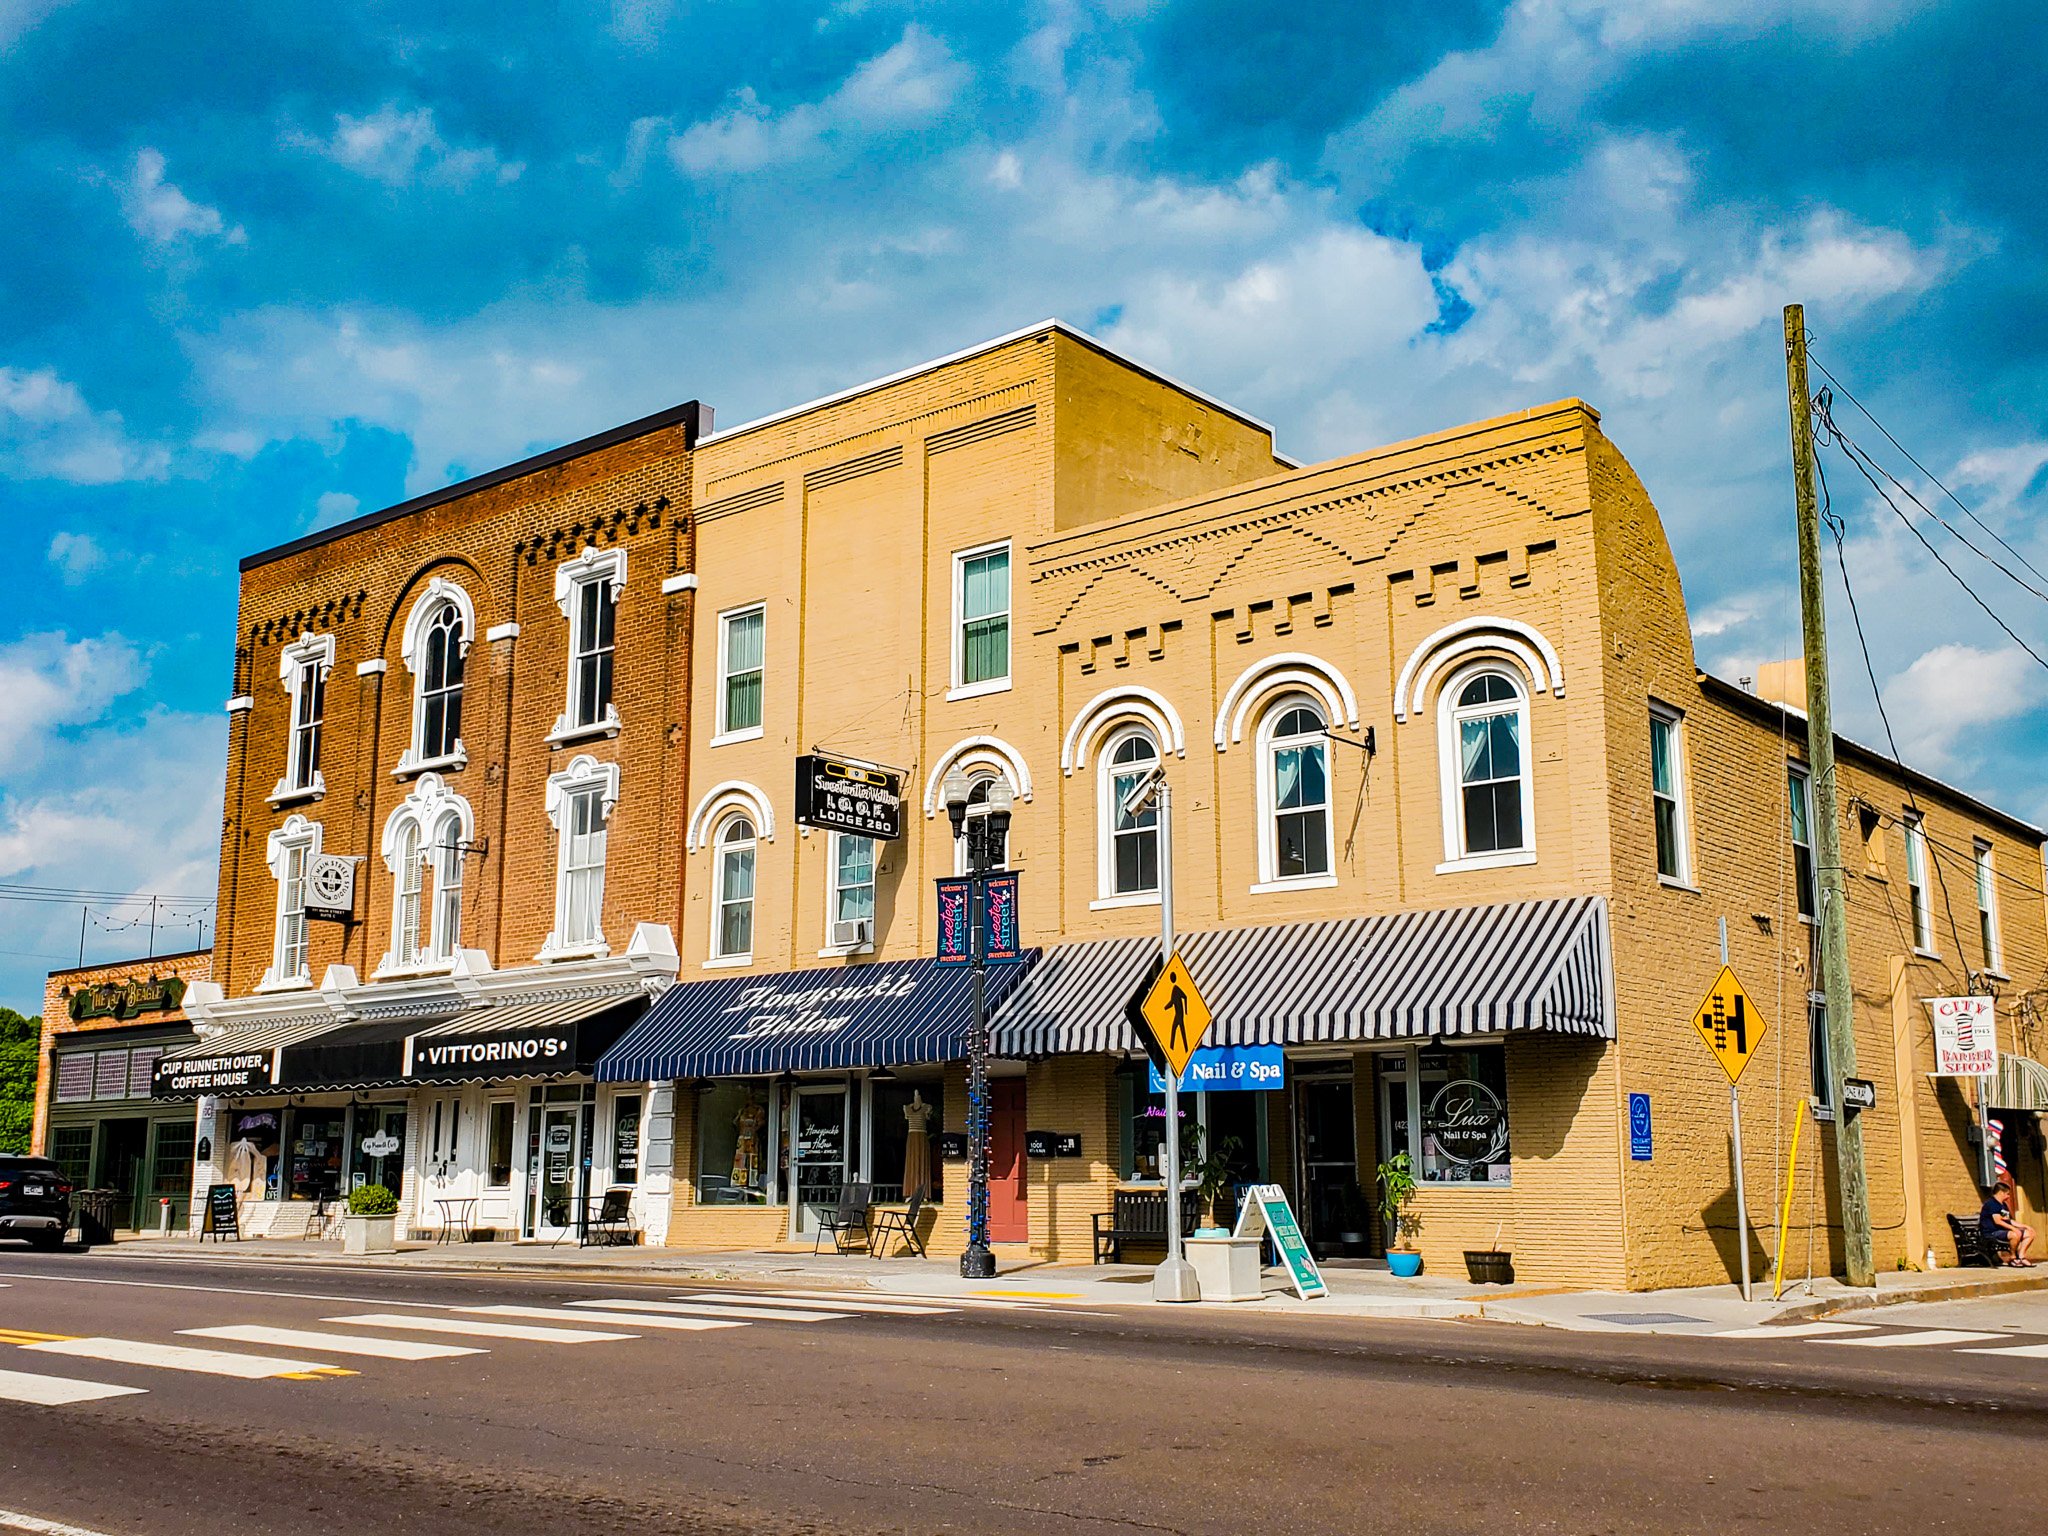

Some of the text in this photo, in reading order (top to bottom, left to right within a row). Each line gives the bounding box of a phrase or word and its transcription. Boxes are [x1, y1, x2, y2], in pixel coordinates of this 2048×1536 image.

[819, 808, 892, 832] LODGE 280
[315, 861, 329, 874] MAIN
[330, 861, 349, 879] STREET
[333, 881, 350, 900] STUDIO
[940, 894, 957, 954] sweetest
[953, 906, 963, 951] street
[988, 889, 1005, 950] sweetest
[1000, 902, 1010, 947] street
[127, 982, 165, 1007] BEAGLE
[722, 973, 917, 1013] Honeysuckle
[1940, 1000, 1989, 1016] CITY
[728, 1010, 852, 1040] Hollow
[428, 1038, 558, 1064] VITTORINO'S
[1942, 1049, 1994, 1062] BARBER
[161, 1054, 262, 1075] CUP RUNNETH OVER
[1192, 1061, 1281, 1081] Nail & Spa
[1945, 1062, 1992, 1073] SHOP
[171, 1071, 249, 1089] COFFEE HOUSE
[1438, 1097, 1491, 1128] Lux
[1444, 1131, 1487, 1141] Nail & Spa
